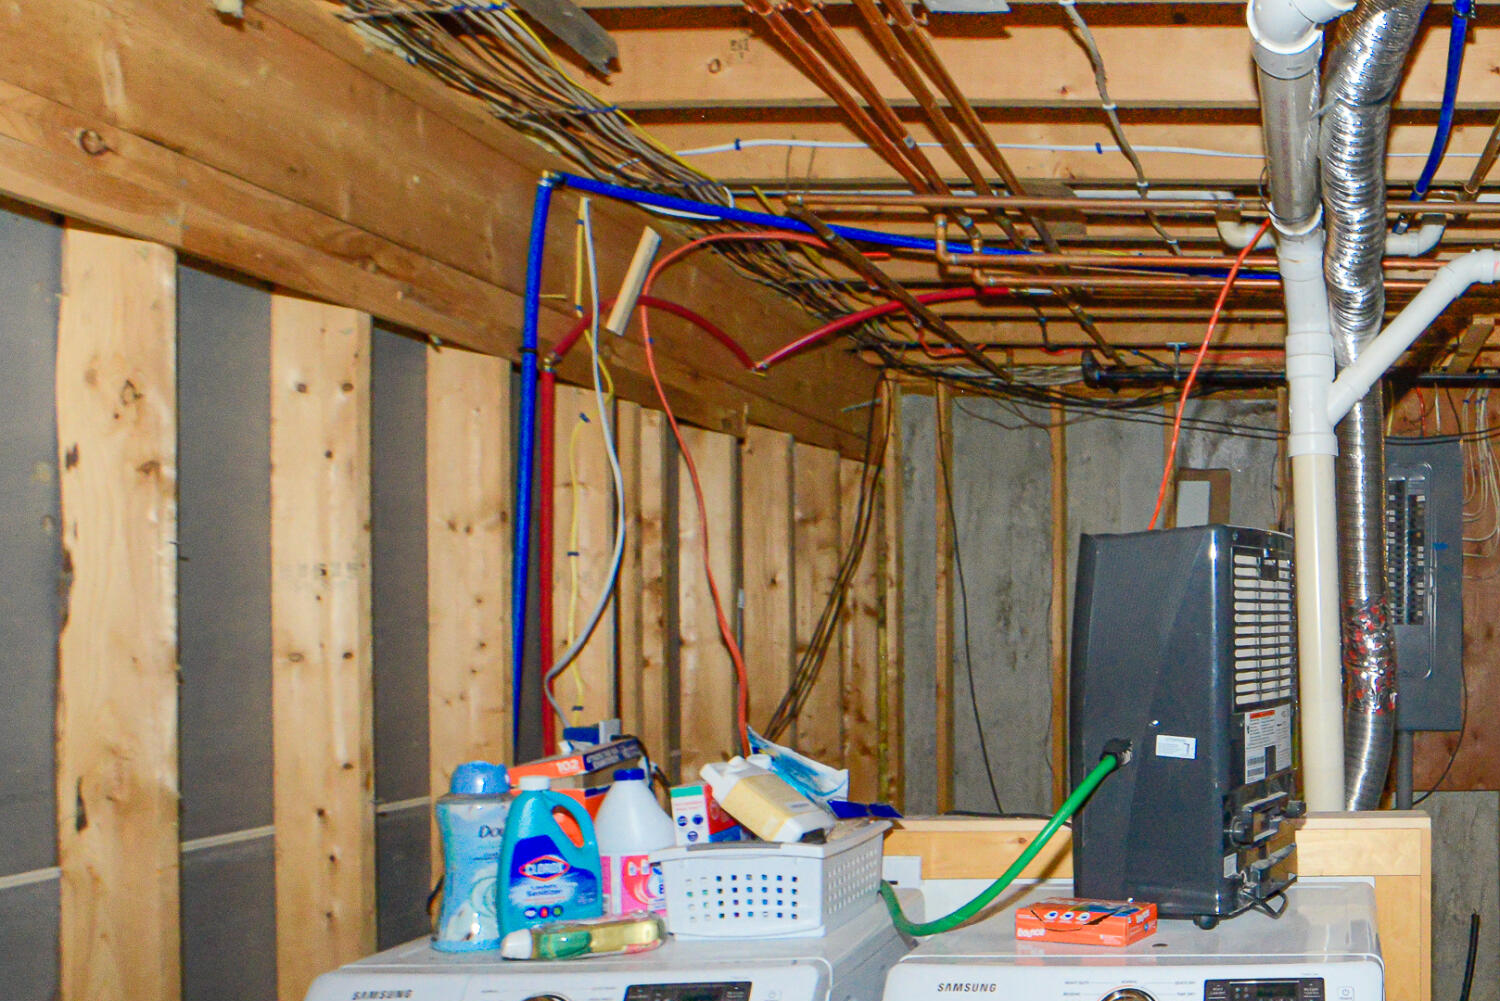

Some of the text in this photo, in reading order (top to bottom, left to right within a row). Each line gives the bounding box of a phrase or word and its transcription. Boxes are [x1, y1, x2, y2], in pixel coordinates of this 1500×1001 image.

[556, 759, 579, 773] 102
[524, 862, 563, 876] CLOROX
[352, 988, 413, 1000] SAMSUNG
[937, 982, 998, 993] SAMSUNG
